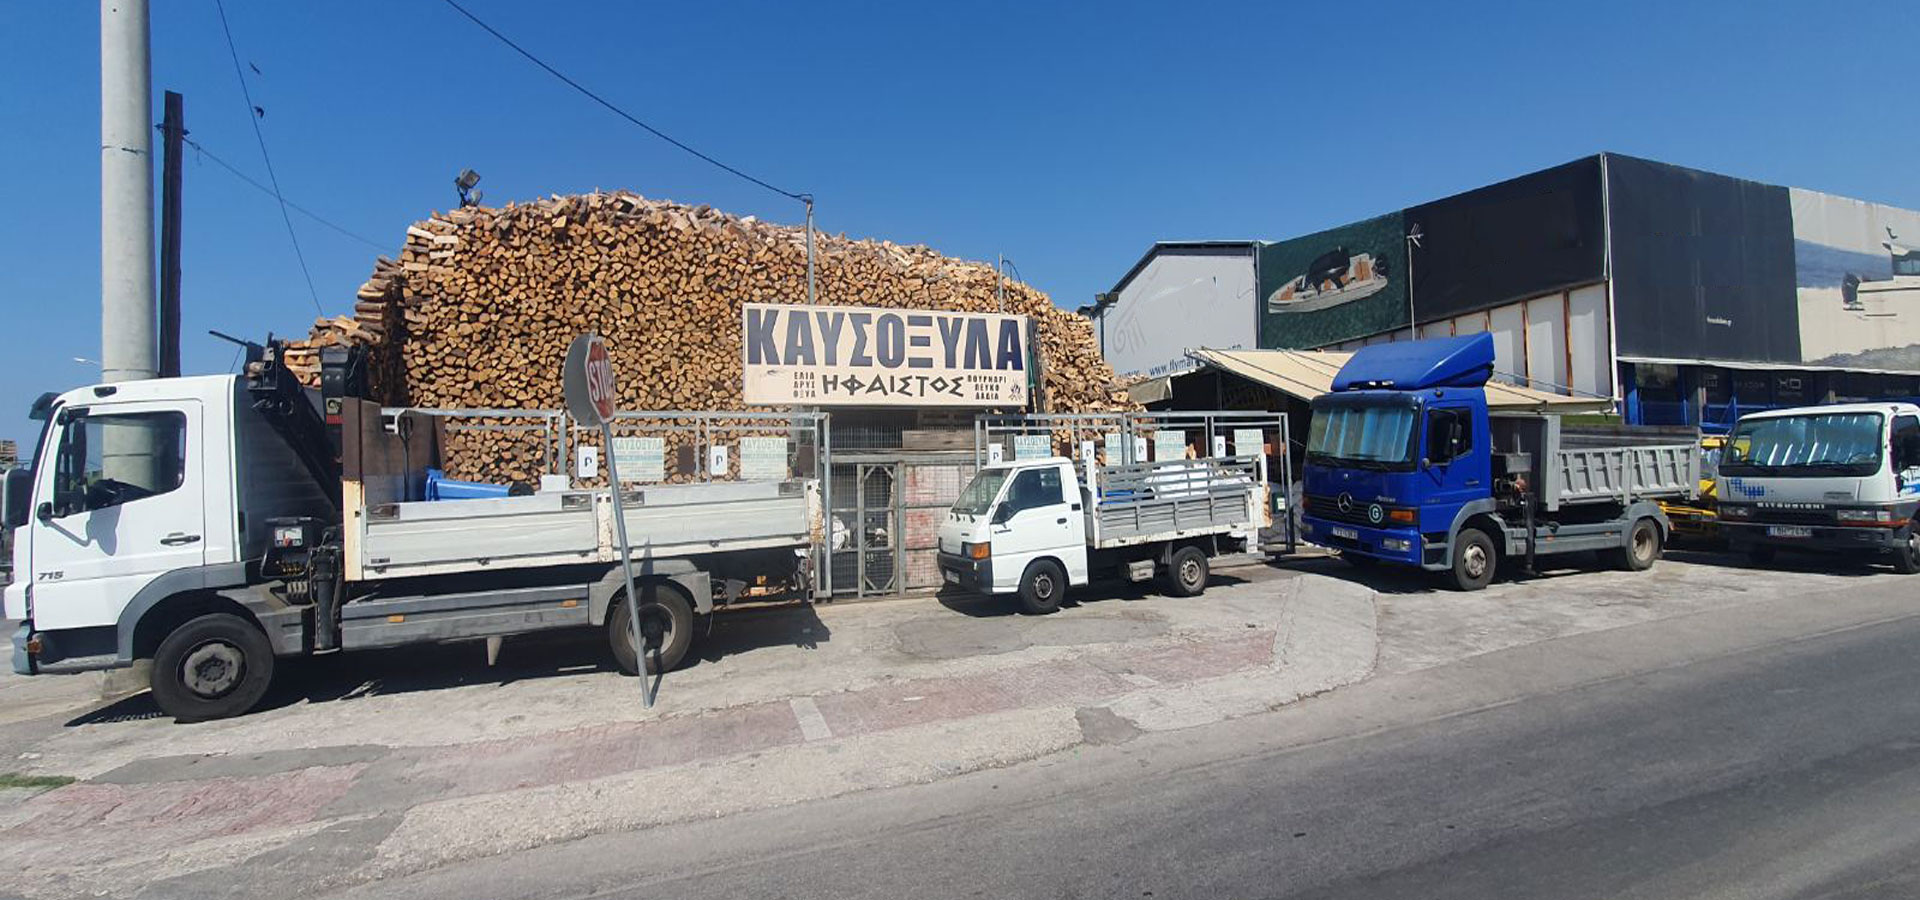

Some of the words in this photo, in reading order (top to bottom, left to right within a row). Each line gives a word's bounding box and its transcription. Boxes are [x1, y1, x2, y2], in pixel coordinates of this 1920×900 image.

[746, 308, 1023, 371] ΚΑΥΣΟΞΥΛΑ
[588, 359, 615, 402] STOP
[822, 373, 964, 397] ΗΦΑΙΣΤΟΣ
[974, 383, 1000, 392] ΠΕΥΚΟ
[38, 570, 65, 581] 715
